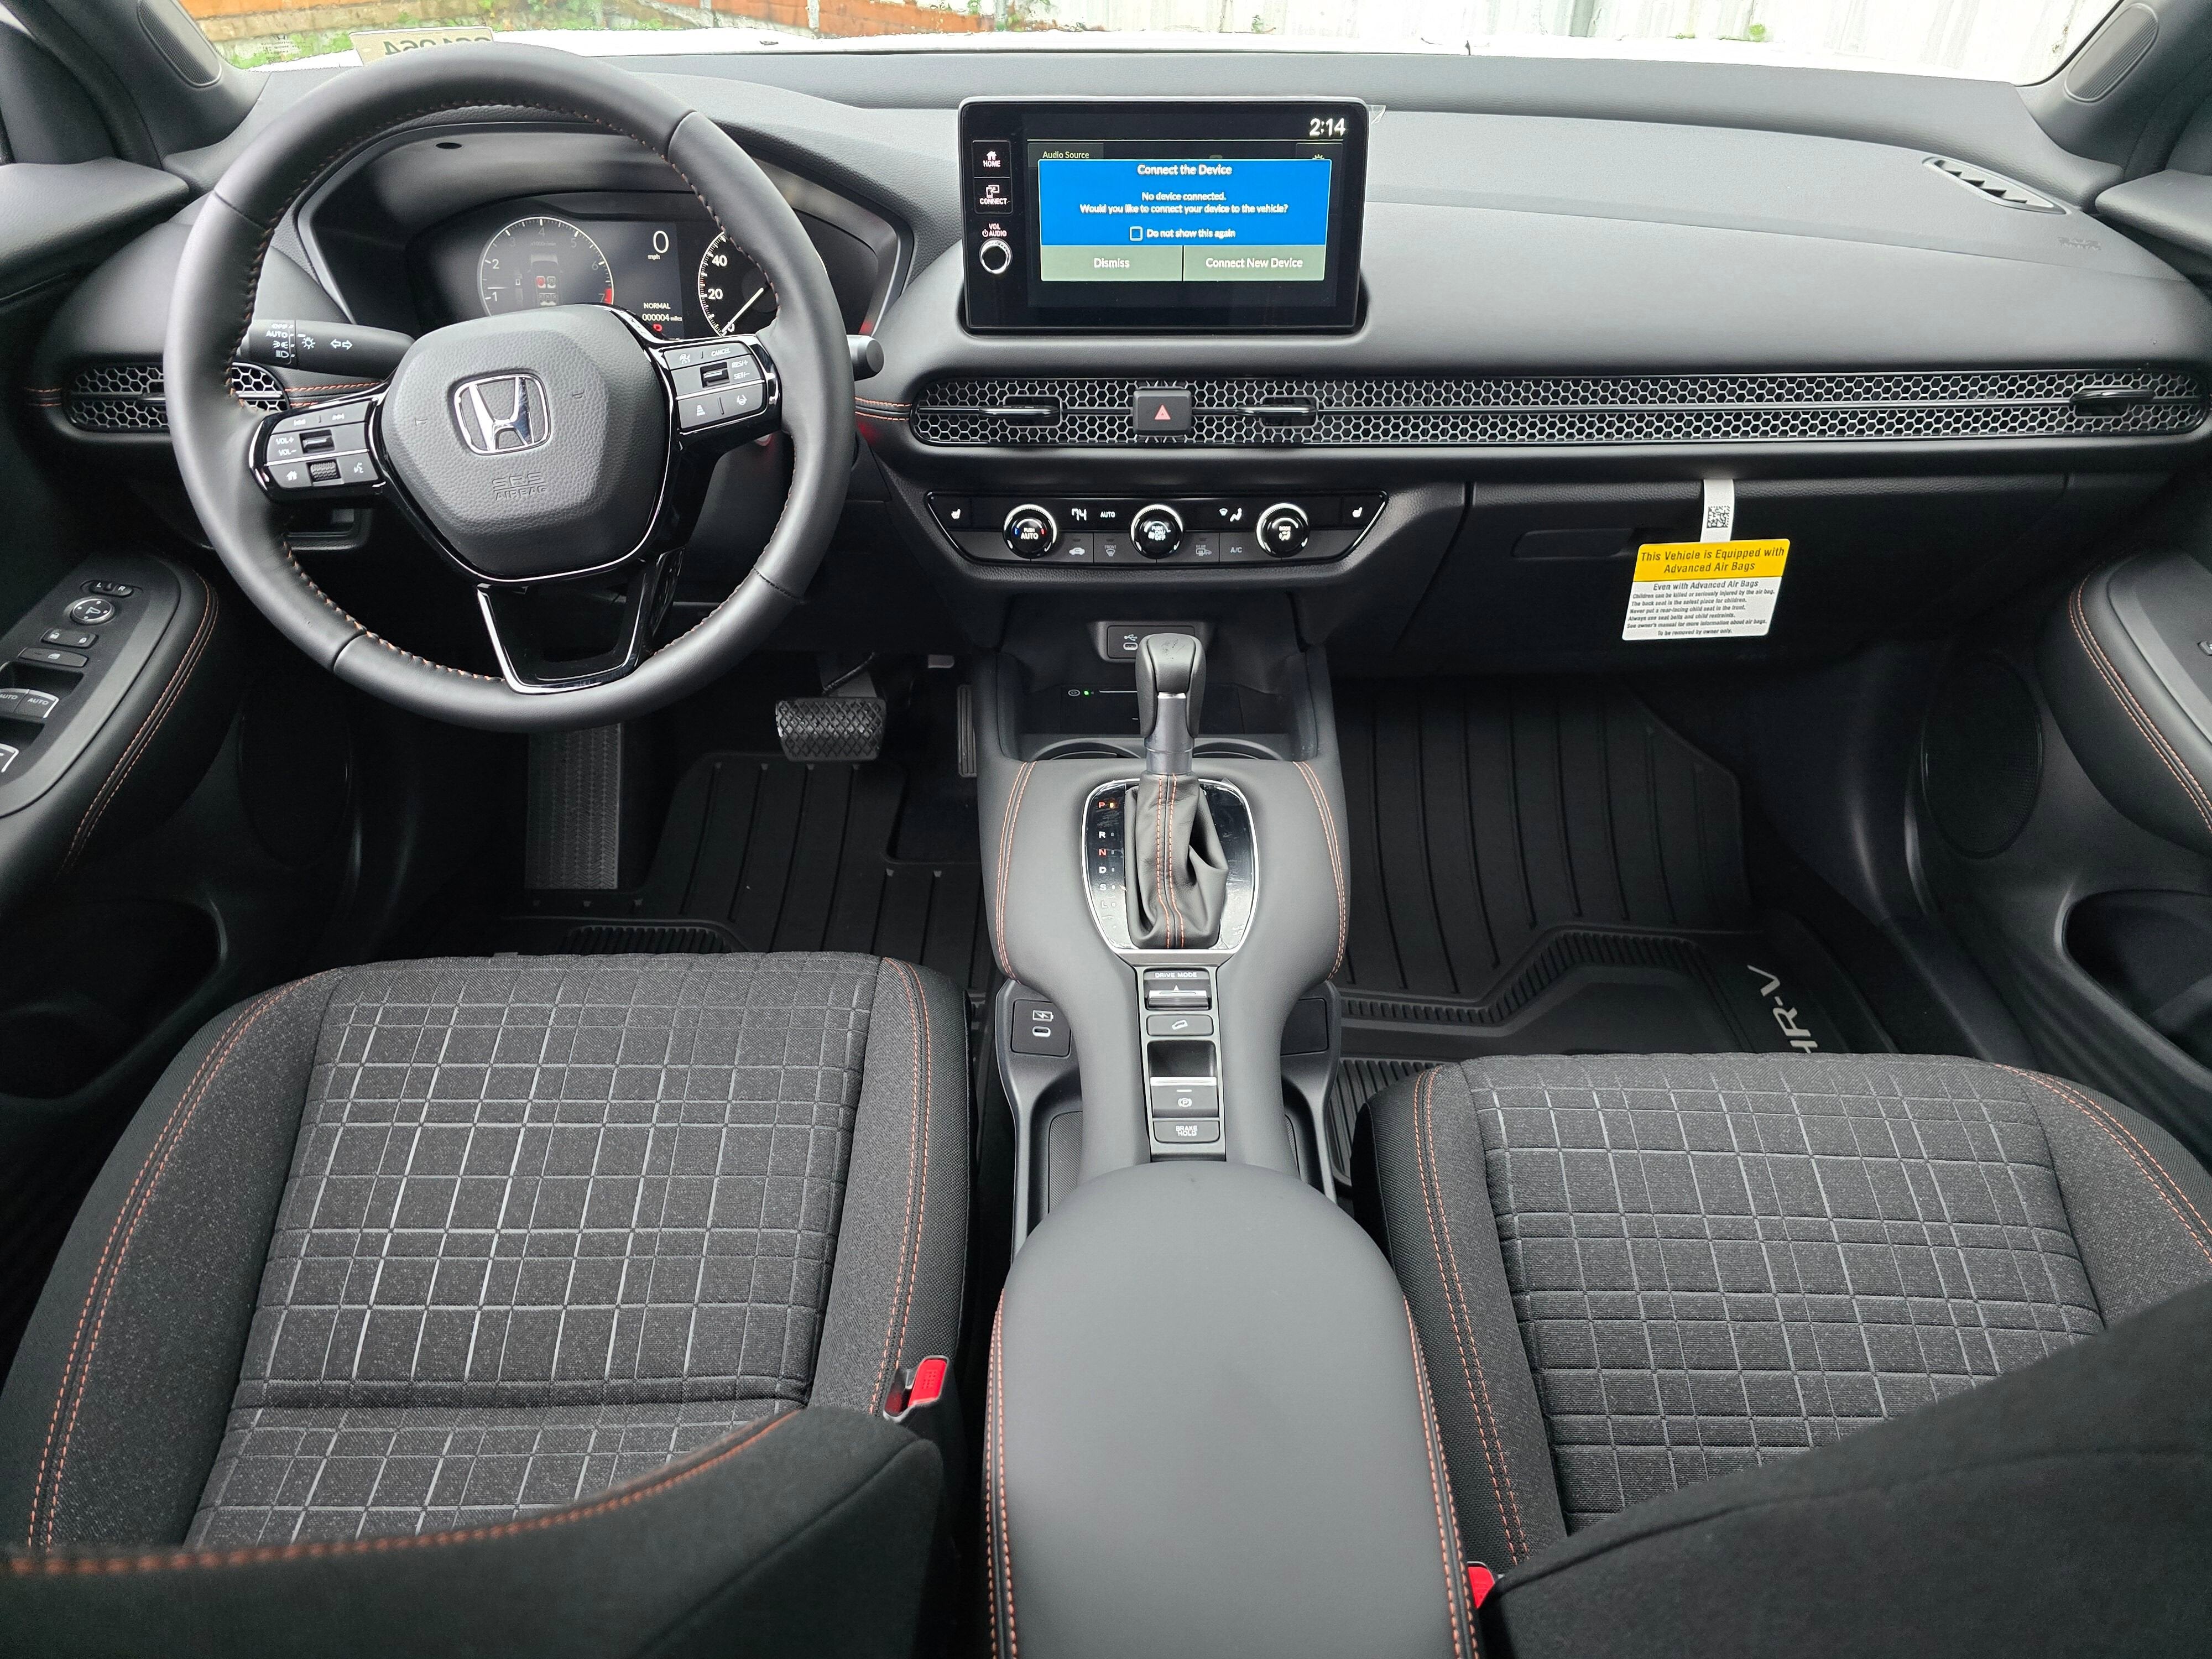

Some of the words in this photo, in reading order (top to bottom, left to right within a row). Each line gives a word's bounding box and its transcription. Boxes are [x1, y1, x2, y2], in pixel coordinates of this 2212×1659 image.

[1310, 118, 1345, 136] 2:14
[1137, 164, 1178, 175] Connect
[1180, 164, 1196, 175] the
[1198, 164, 1233, 175] Device
[1141, 192, 1154, 201] No
[1156, 192, 1181, 201] device
[1183, 192, 1227, 201] connected.
[1079, 204, 1107, 213] Would
[1108, 206, 1123, 214] you
[1125, 204, 1139, 213] like
[1140, 205, 1150, 213] to
[1151, 205, 1183, 213] connect
[1184, 206, 1202, 215] your
[1204, 204, 1230, 213] device
[1231, 205, 1240, 213] to
[1241, 204, 1255, 213] the
[1256, 204, 1288, 213] vehicle?
[539, 227, 545, 237] 4
[1146, 229, 1159, 238] Do
[1160, 229, 1174, 238] not
[1175, 229, 1197, 238] show
[1198, 228, 1213, 238] this
[1214, 228, 1236, 239] again
[509, 237, 516, 247] 3
[570, 238, 577, 248] 5
[653, 231, 669, 253] 0
[492, 259, 499, 269] 2
[592, 260, 598, 270] 6
[712, 255, 728, 267] 40
[1094, 258, 1130, 268] Dismiss
[1206, 258, 1245, 268] Connect
[1246, 258, 1269, 268] New
[1271, 258, 1303, 268] Device
[492, 292, 497, 301] 1
[598, 293, 605, 302] 7
[708, 289, 723, 300] 20
[711, 348, 731, 357] CANCEL
[492, 472, 542, 489] SRS
[495, 485, 547, 501] AIRBAG
[1071, 508, 1087, 521] 74
[1641, 552, 1661, 561] This
[1665, 551, 1700, 560] Vehicle
[1704, 550, 1712, 559] is
[1715, 547, 1760, 560] Equipped
[1764, 547, 1785, 557] with
[1664, 563, 1711, 573] Advanced
[1714, 562, 1729, 571] Air
[1731, 562, 1755, 572] Bags
